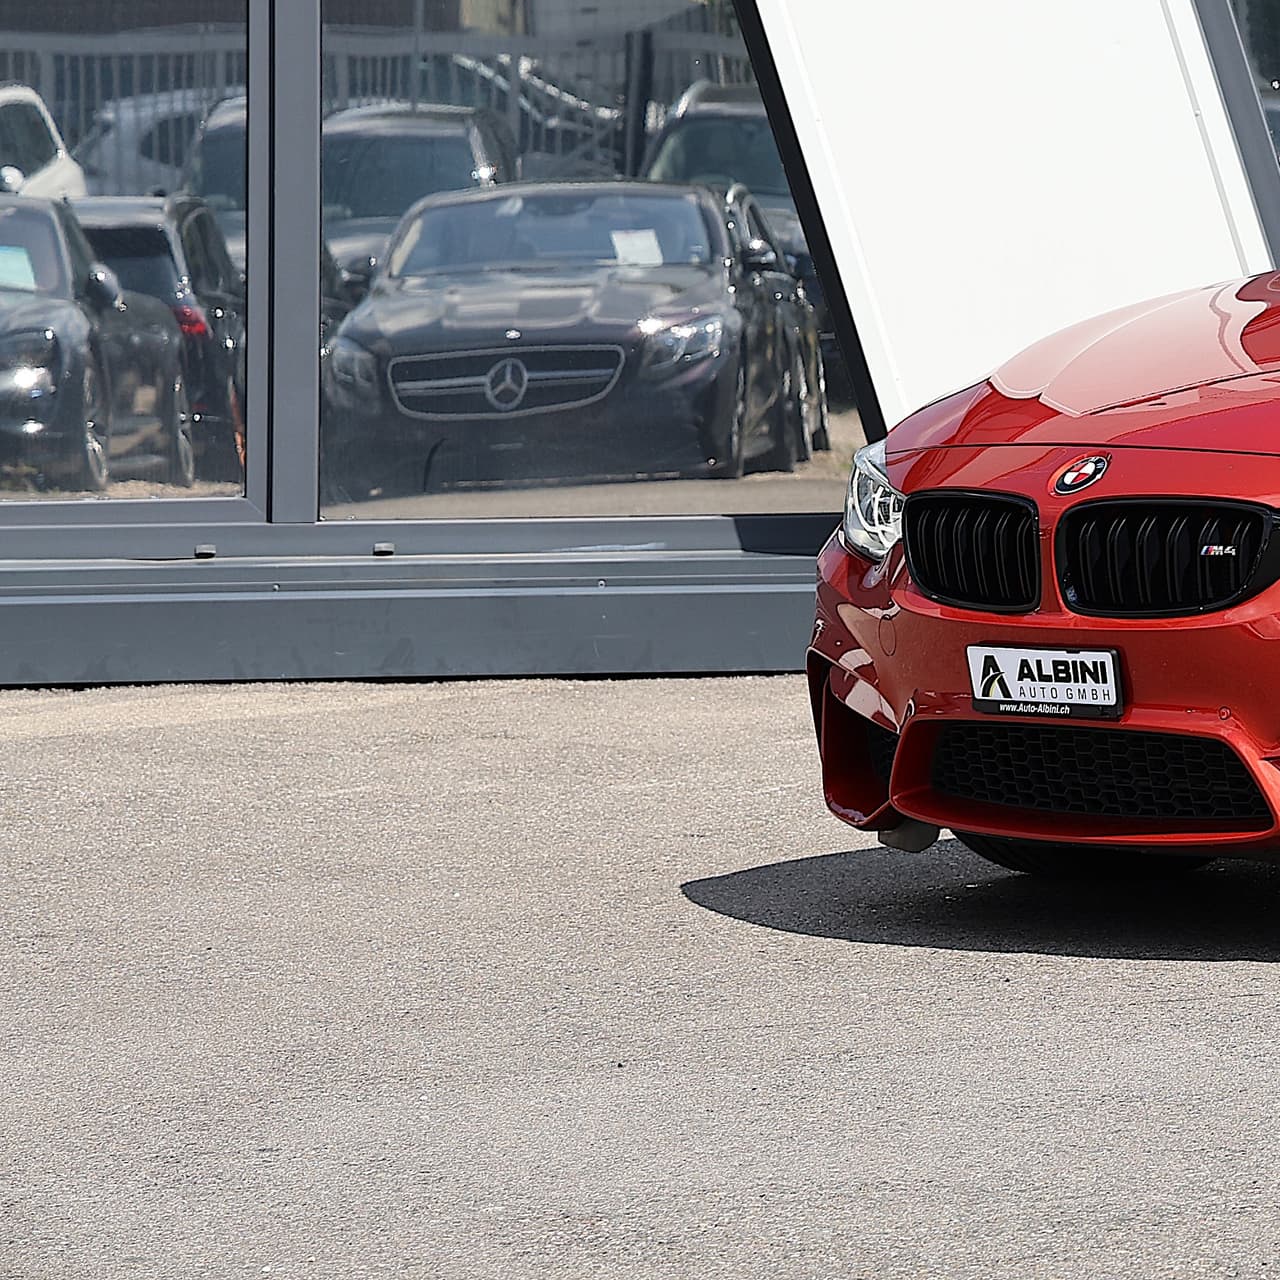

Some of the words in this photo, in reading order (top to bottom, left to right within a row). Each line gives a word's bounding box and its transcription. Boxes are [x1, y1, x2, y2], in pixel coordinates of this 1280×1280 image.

[1017, 658, 1108, 684] ALBINI
[1019, 686, 1058, 699] AUTO
[1065, 687, 1111, 701] GMBH
